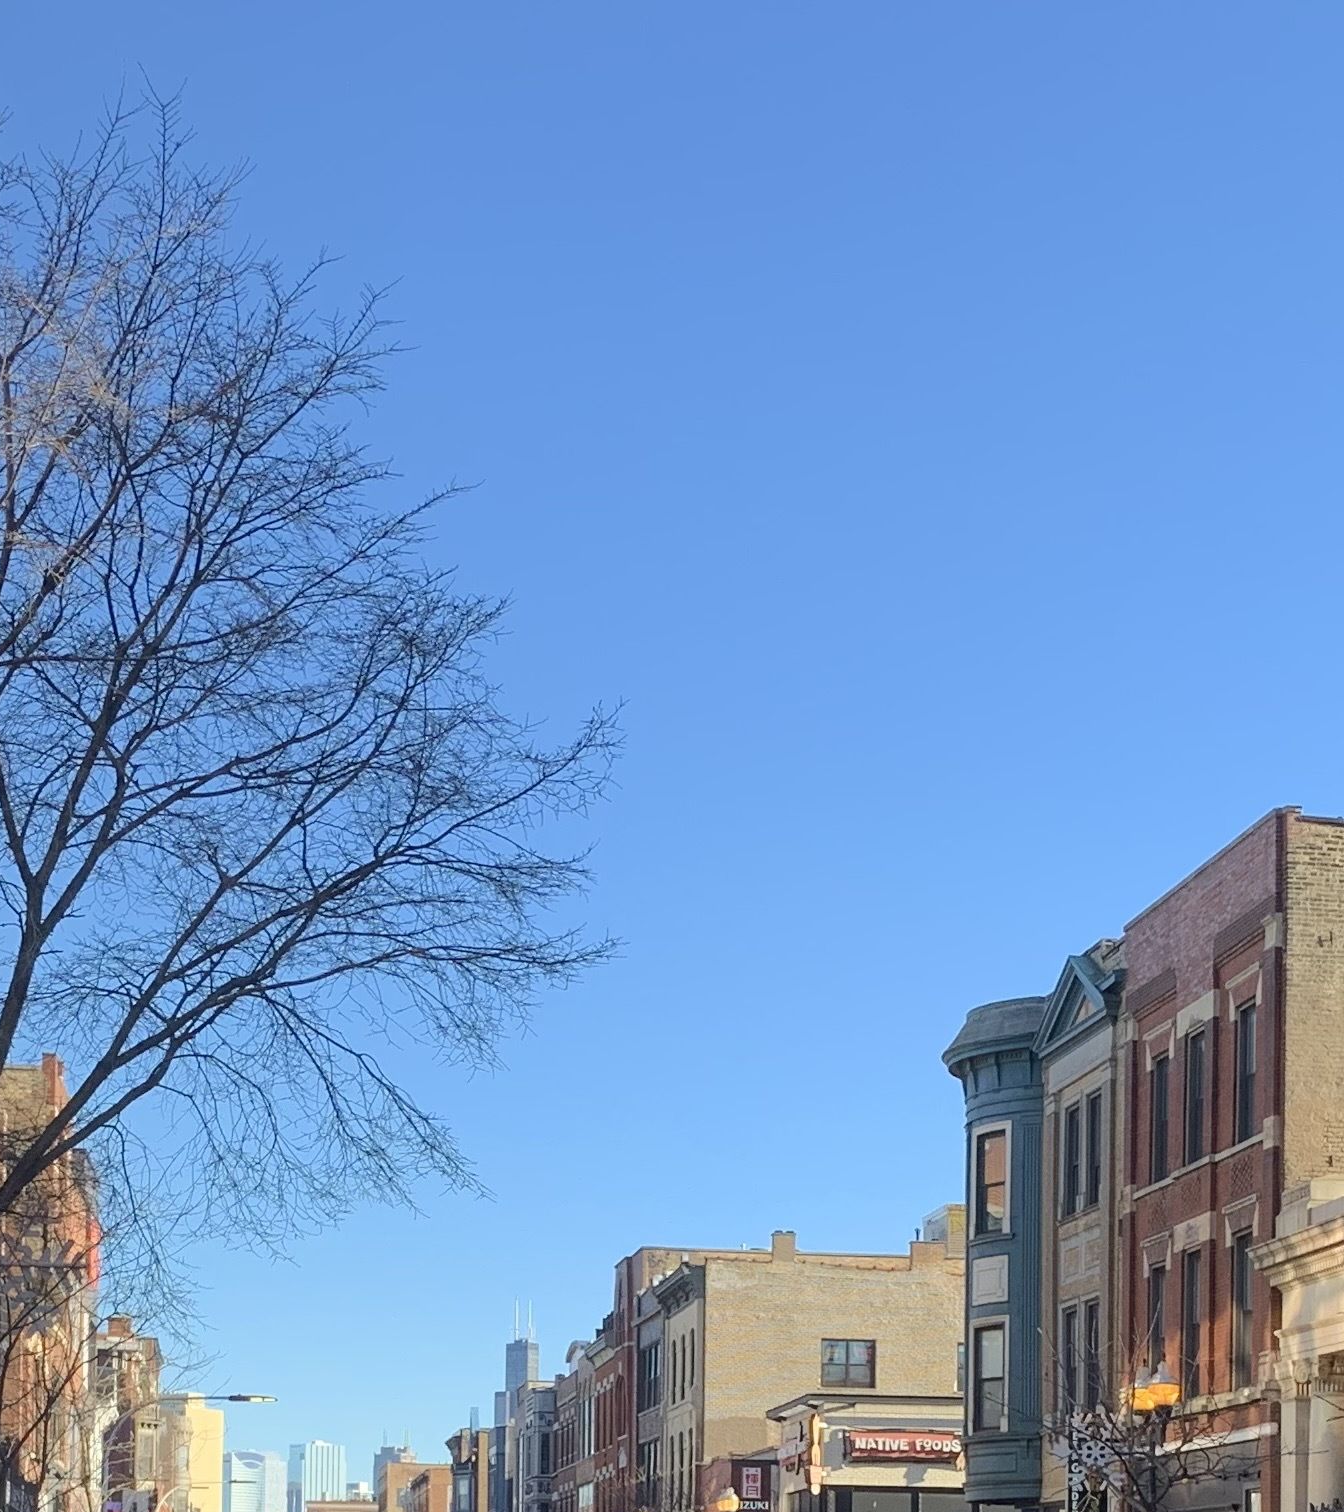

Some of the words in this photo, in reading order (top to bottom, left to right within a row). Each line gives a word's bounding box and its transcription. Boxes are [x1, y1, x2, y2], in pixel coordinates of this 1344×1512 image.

[855, 1437, 909, 1452] NATIVE
[915, 1439, 962, 1453] FOODS
[739, 1501, 769, 1510] IZUKI
